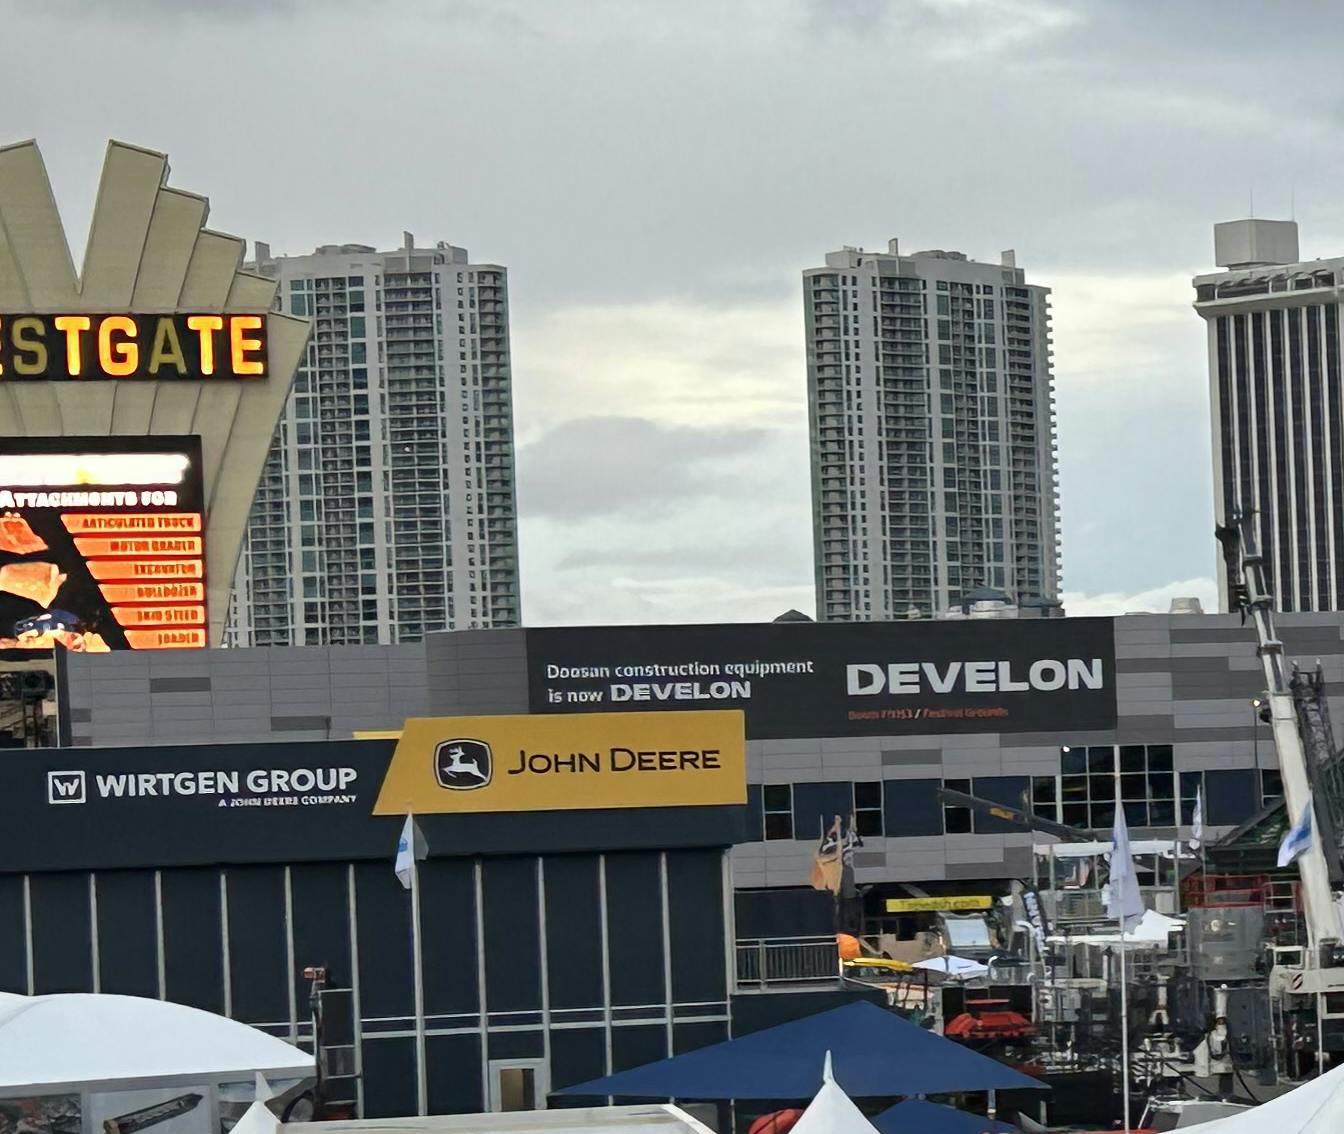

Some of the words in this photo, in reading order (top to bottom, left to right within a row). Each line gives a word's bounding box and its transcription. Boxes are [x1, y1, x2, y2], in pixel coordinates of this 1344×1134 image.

[0, 316, 265, 376] STGATE
[547, 664, 610, 680] Doosan
[615, 662, 720, 677] construction
[725, 660, 814, 678] equipment
[846, 659, 1104, 696] DEVELON
[549, 688, 562, 703] is
[567, 690, 603, 703] now
[610, 681, 751, 702] DEVELON
[508, 750, 600, 775] JOHN
[611, 748, 721, 773] DEERE
[96, 772, 238, 798] WIRTGEN
[246, 768, 358, 793] GROUP
